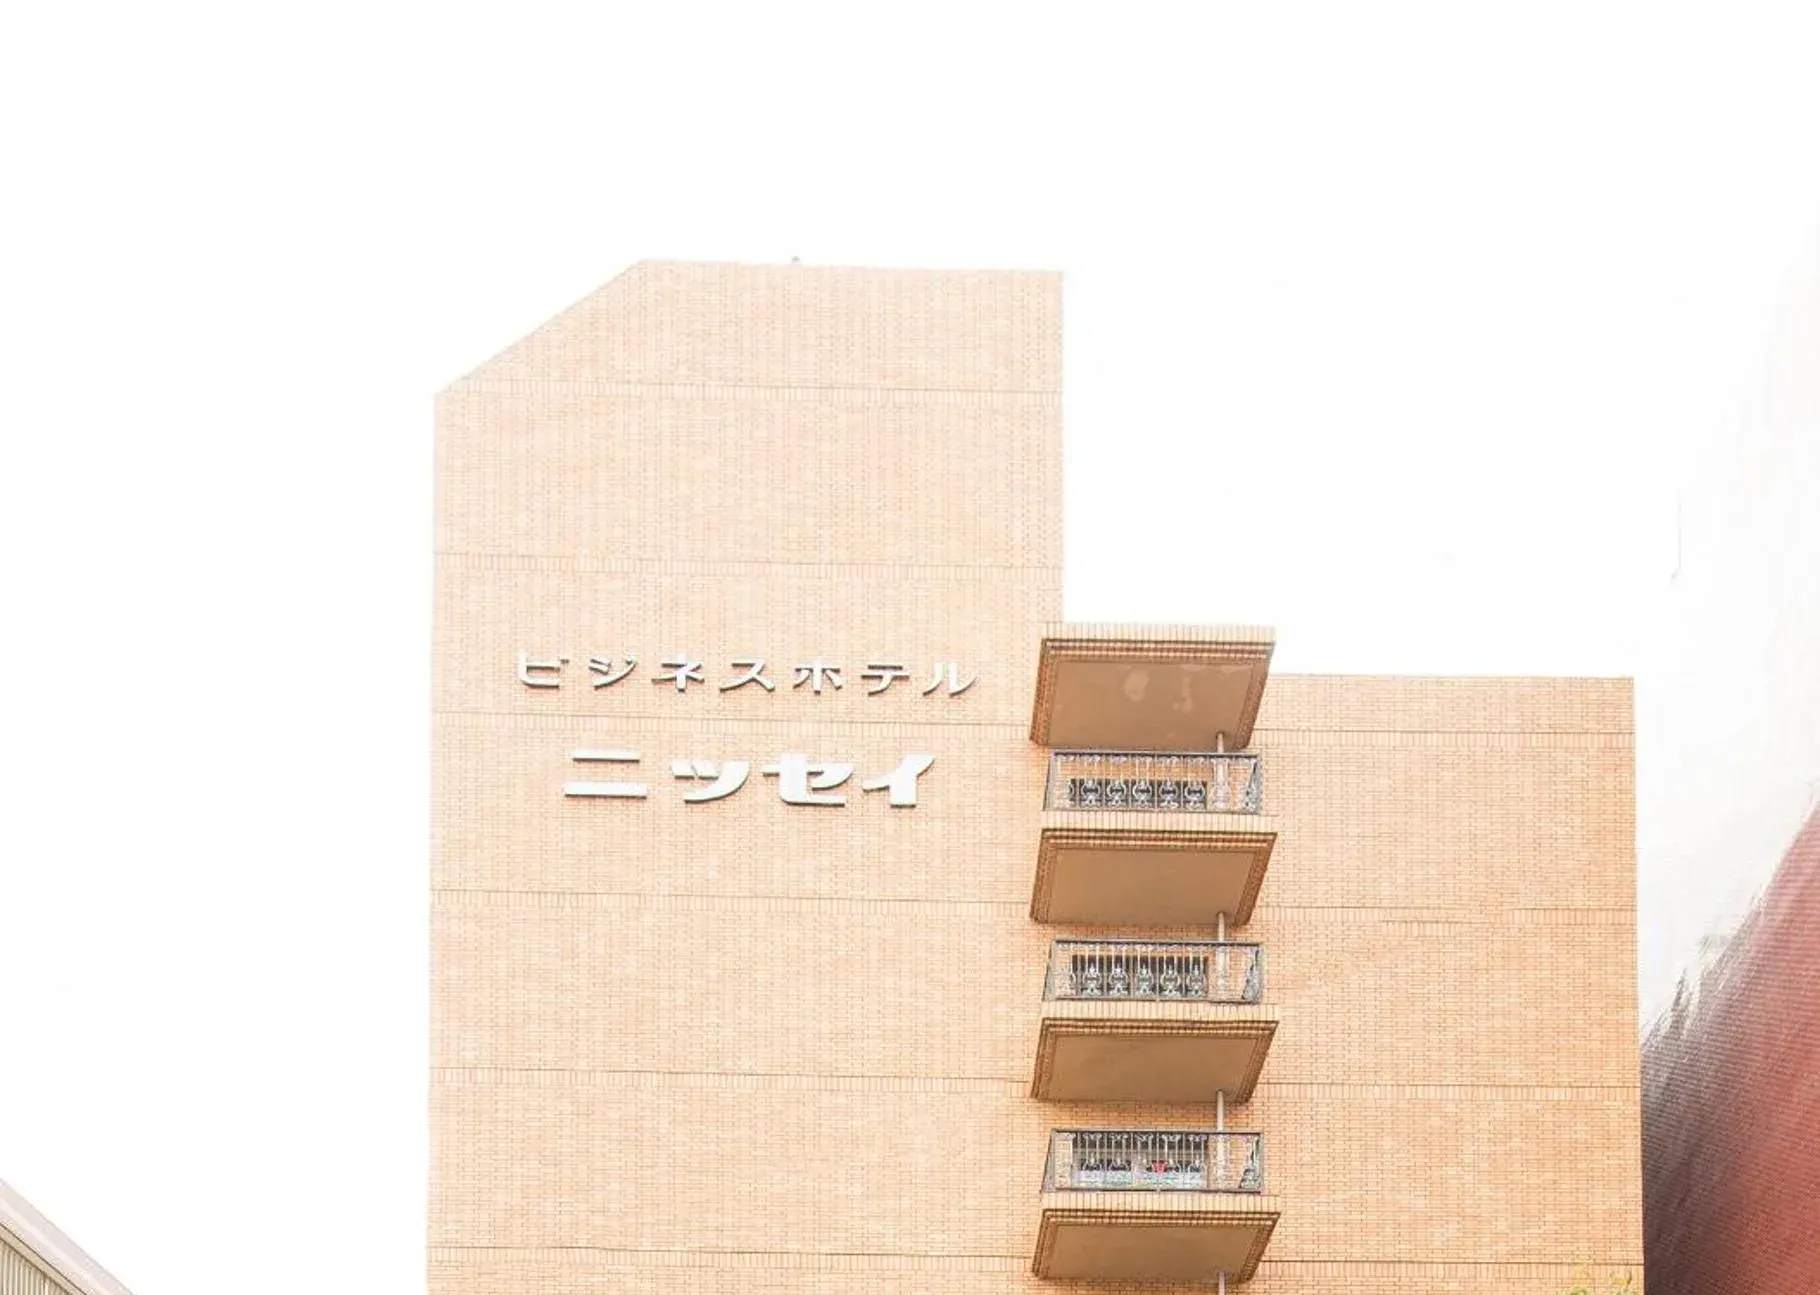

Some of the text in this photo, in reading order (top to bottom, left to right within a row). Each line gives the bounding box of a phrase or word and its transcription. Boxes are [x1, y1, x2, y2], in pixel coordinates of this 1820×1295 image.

[517, 653, 978, 695] ビジネスホテル
[564, 749, 935, 807] ニッセイ
